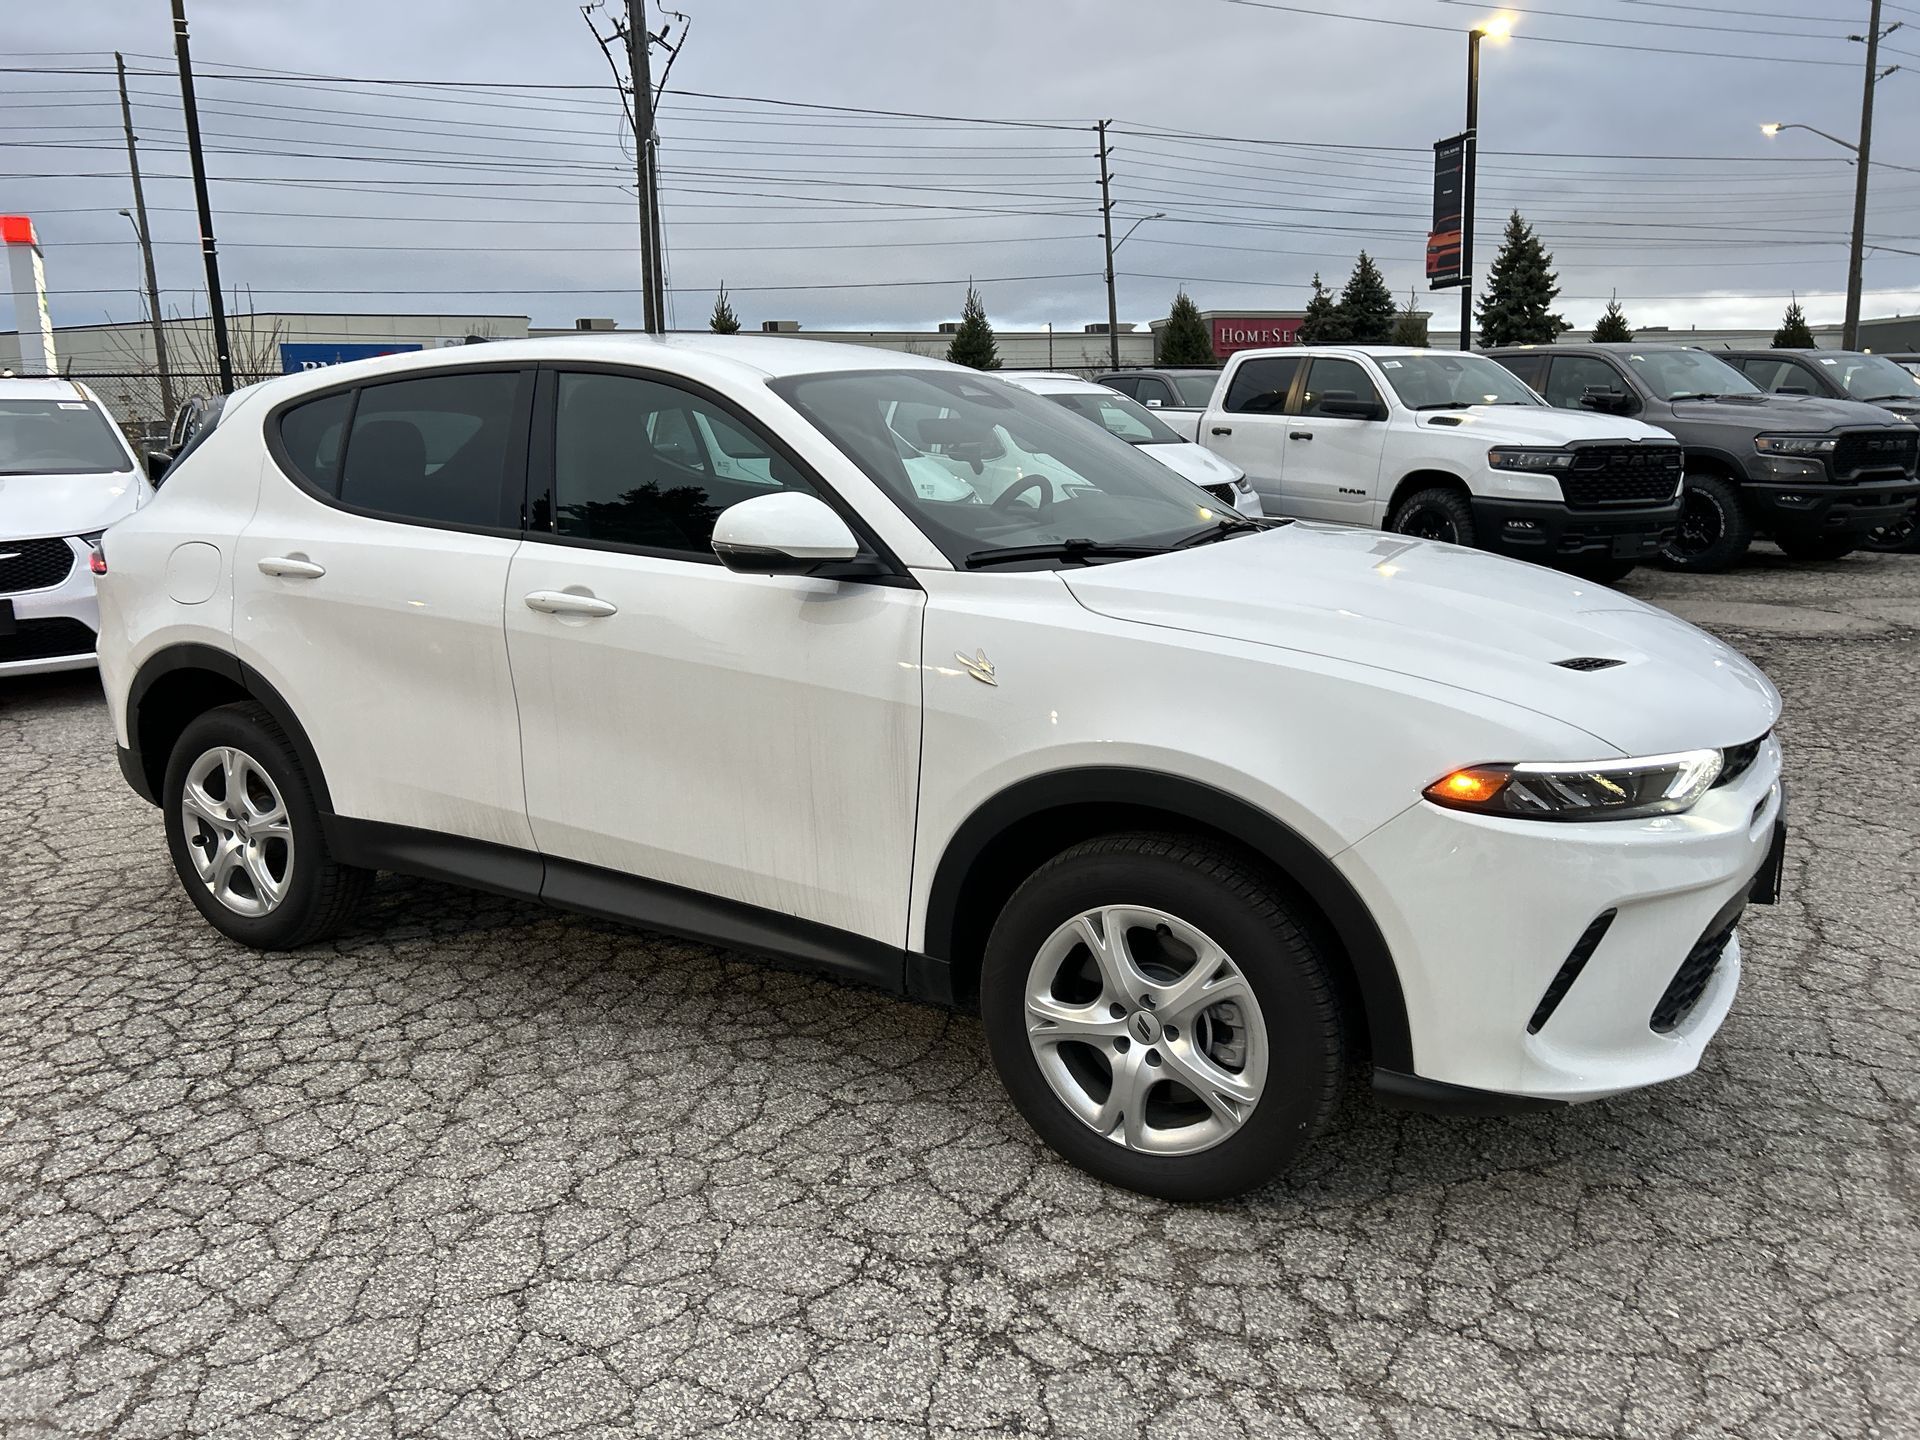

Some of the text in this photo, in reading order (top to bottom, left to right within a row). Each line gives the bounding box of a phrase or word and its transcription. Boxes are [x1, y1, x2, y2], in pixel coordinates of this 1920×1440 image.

[1866, 439, 1908, 451] RAM
[1610, 454, 1664, 466] RAM
[1338, 487, 1366, 496] RAM
